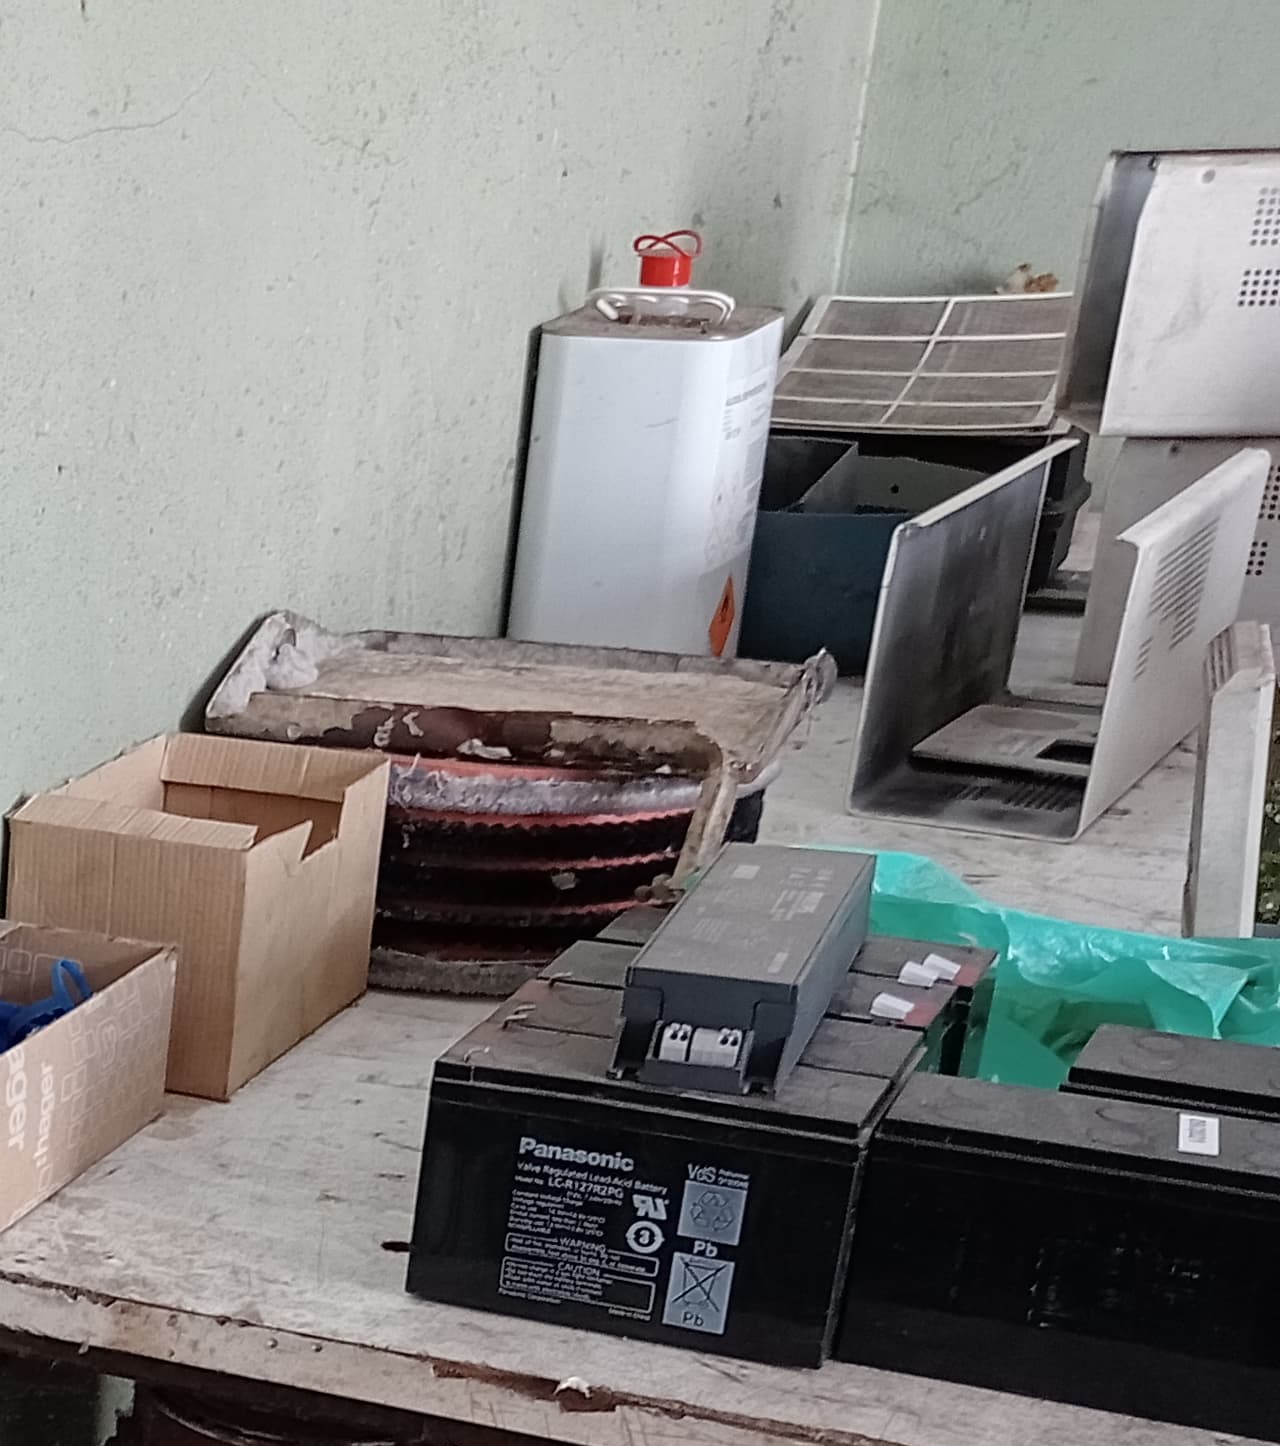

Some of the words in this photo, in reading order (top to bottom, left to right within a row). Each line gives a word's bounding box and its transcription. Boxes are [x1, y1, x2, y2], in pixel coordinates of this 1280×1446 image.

[518, 1136, 634, 1172] Panasonic
[543, 1165, 588, 1180] Regulated
[634, 1180, 668, 1196] Battery
[693, 1240, 718, 1258] Pb
[682, 1311, 705, 1327] Pb
